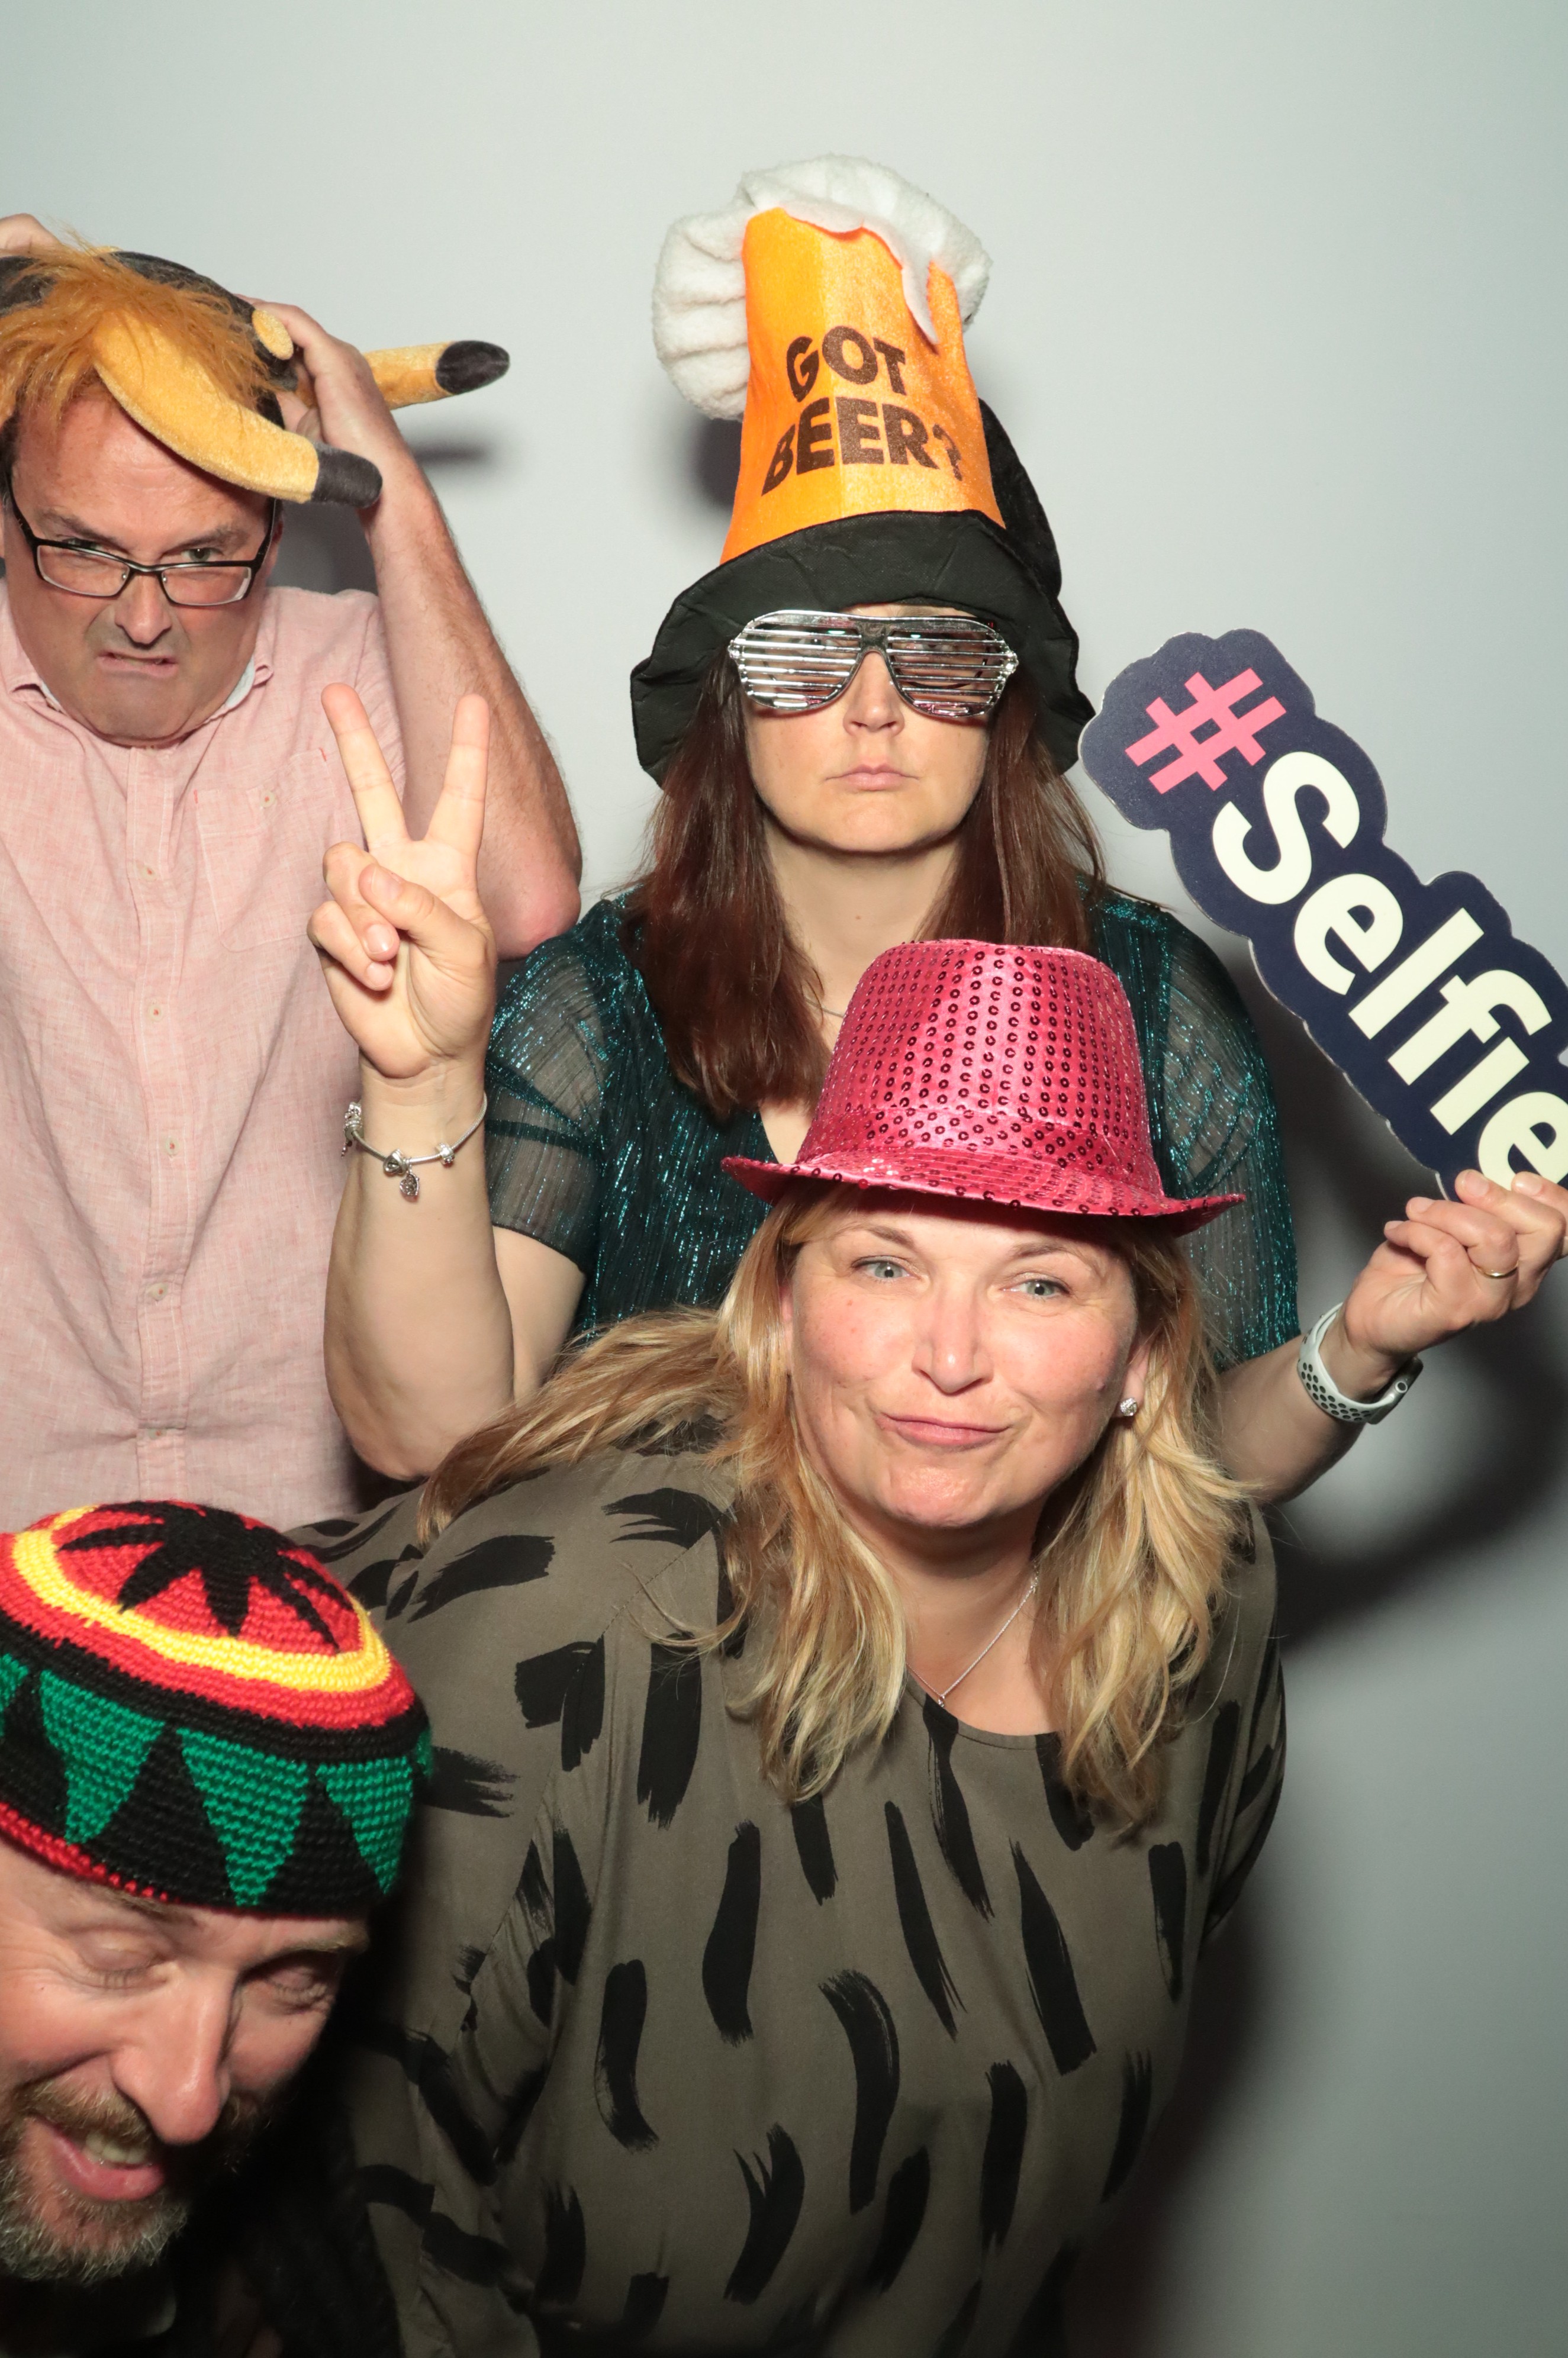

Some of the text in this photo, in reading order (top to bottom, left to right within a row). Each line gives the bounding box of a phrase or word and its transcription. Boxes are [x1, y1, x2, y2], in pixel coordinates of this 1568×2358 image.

[787, 326, 907, 402] GOT
[761, 396, 963, 497] BEER?
[1125, 668, 1568, 1190] #Selfie
